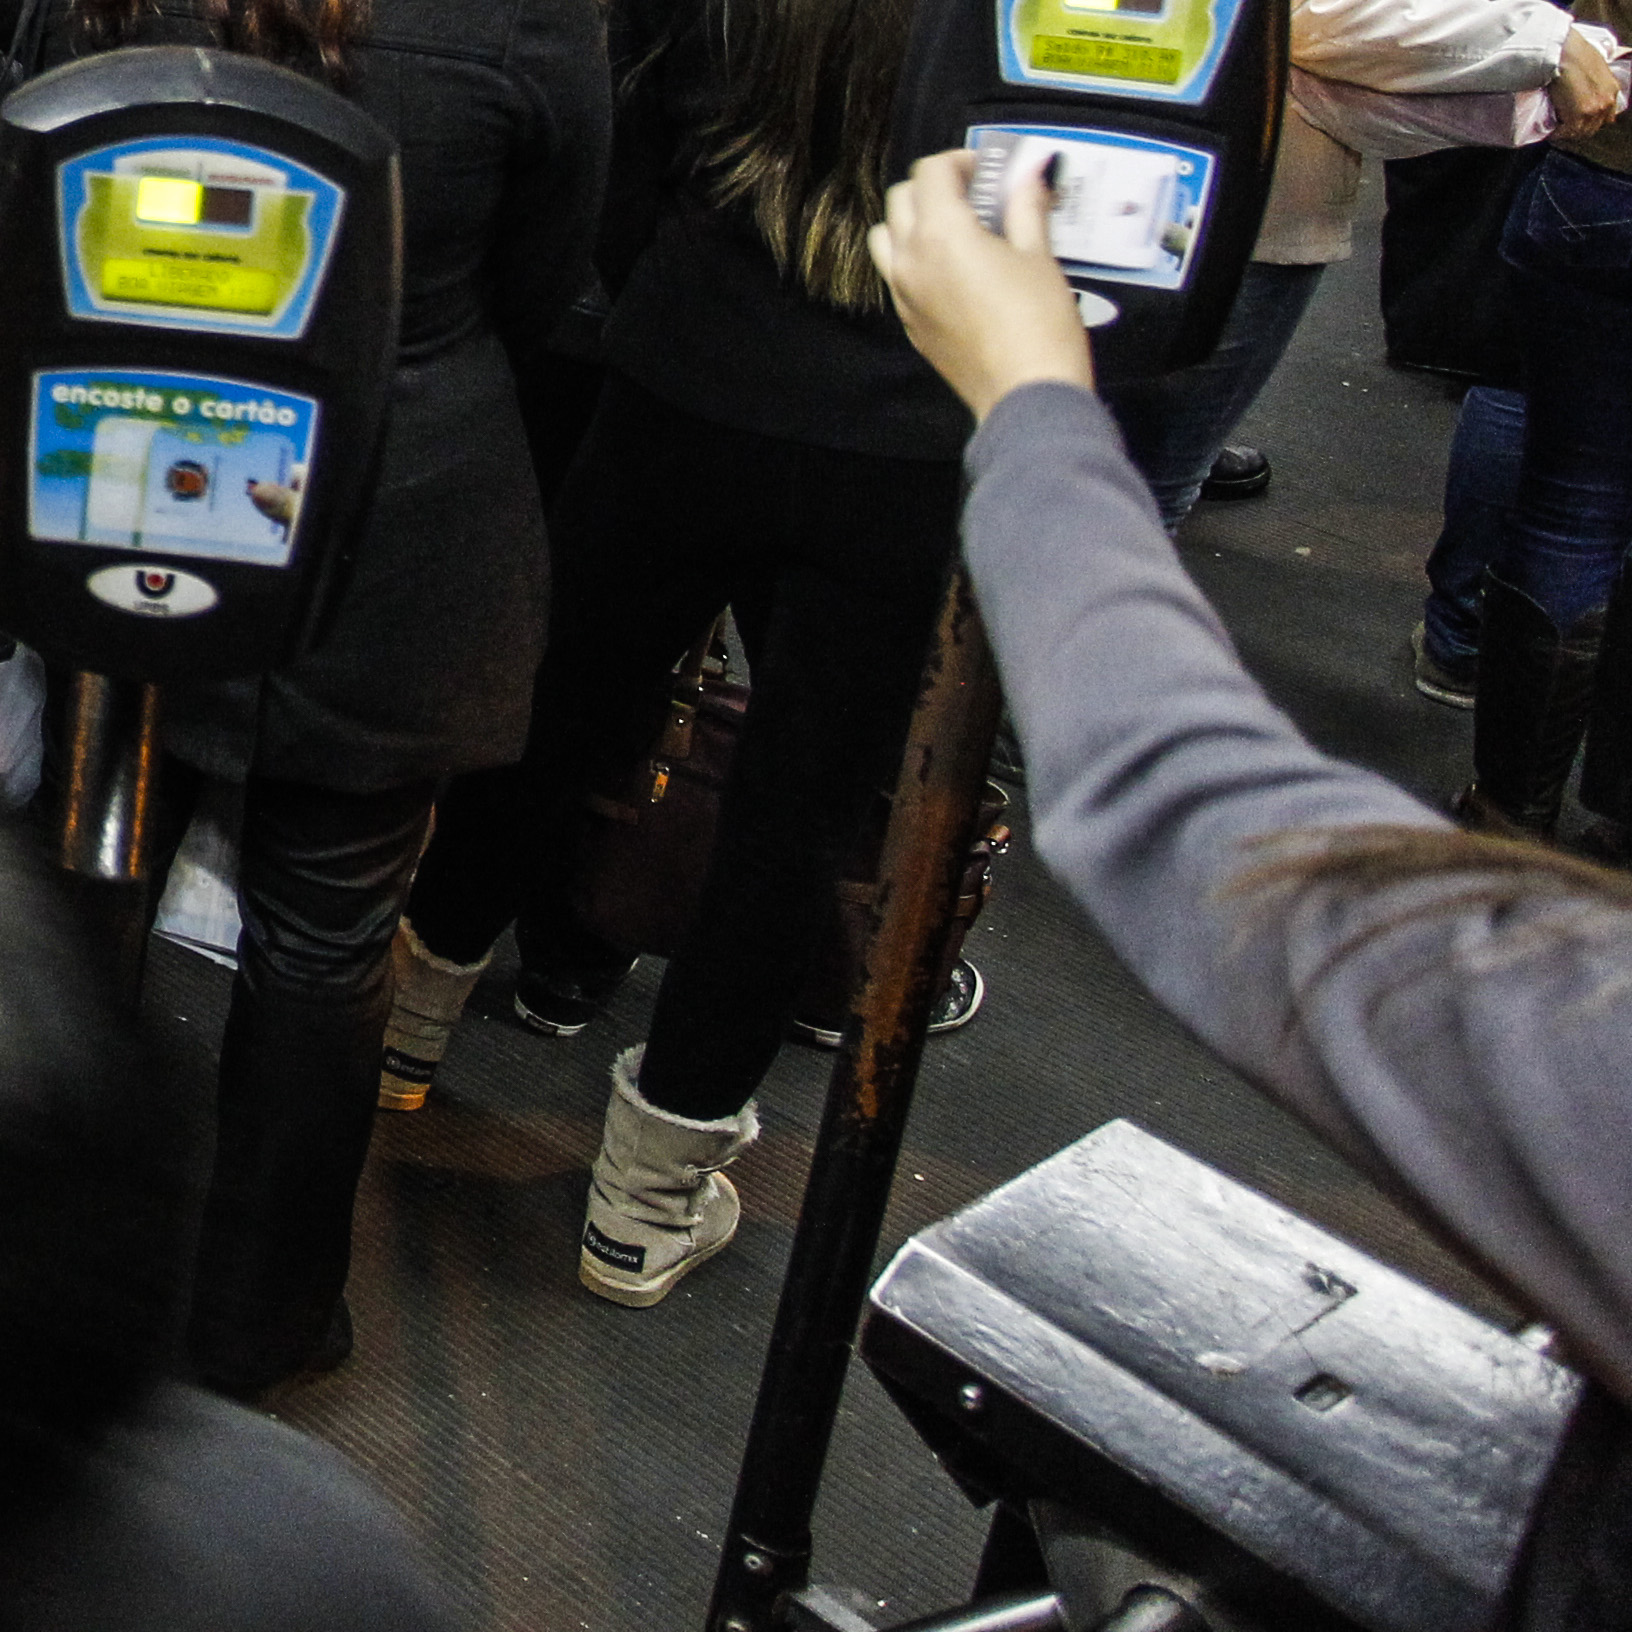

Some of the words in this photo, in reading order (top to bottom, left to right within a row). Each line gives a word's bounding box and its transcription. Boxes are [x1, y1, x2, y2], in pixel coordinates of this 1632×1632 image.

[52, 383, 163, 412] encoste
[171, 396, 193, 416] o
[200, 399, 296, 426] cartão
